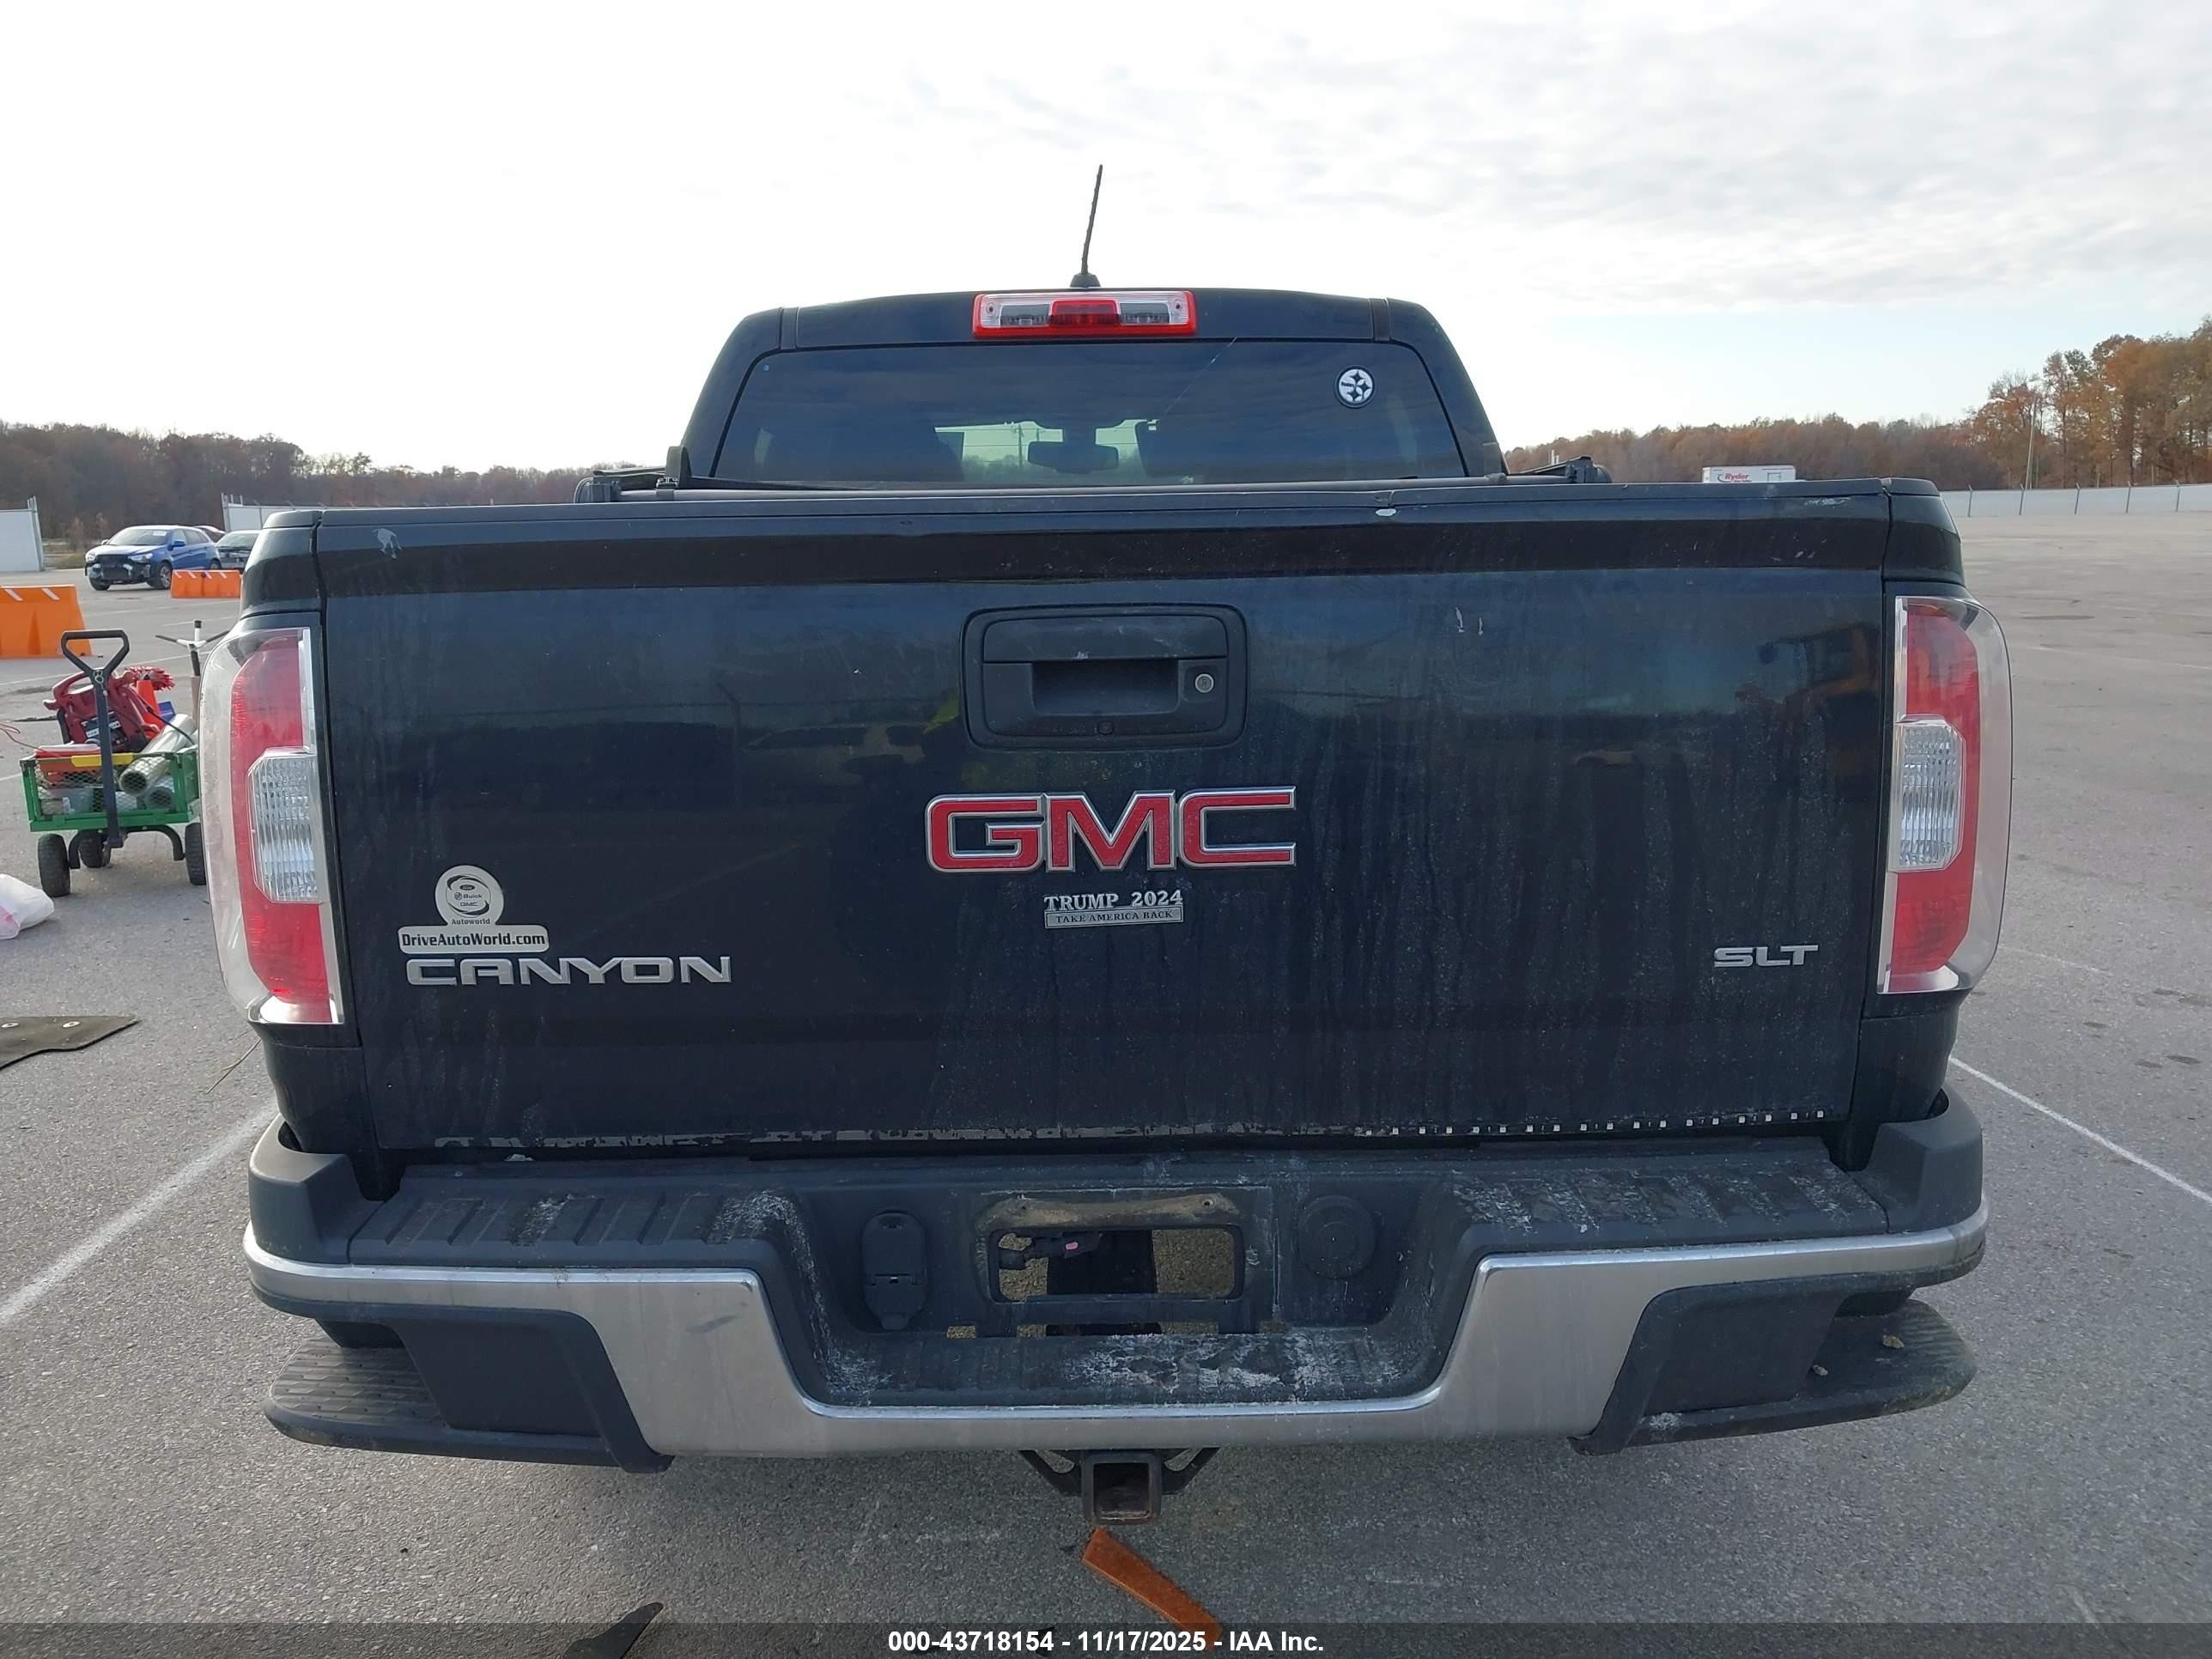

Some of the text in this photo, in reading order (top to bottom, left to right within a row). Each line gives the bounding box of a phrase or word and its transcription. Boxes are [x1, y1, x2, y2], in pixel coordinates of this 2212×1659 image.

[1724, 472, 1749, 481] Ryder
[925, 787, 1296, 872] GMC
[1043, 889, 1183, 911] TRUMP 2024
[1056, 910, 1173, 923] TAKE AMERICA BACK
[402, 932, 546, 948] DriveAutoWorld.com
[1713, 945, 1820, 968] SLT
[405, 956, 732, 987] CANYON
